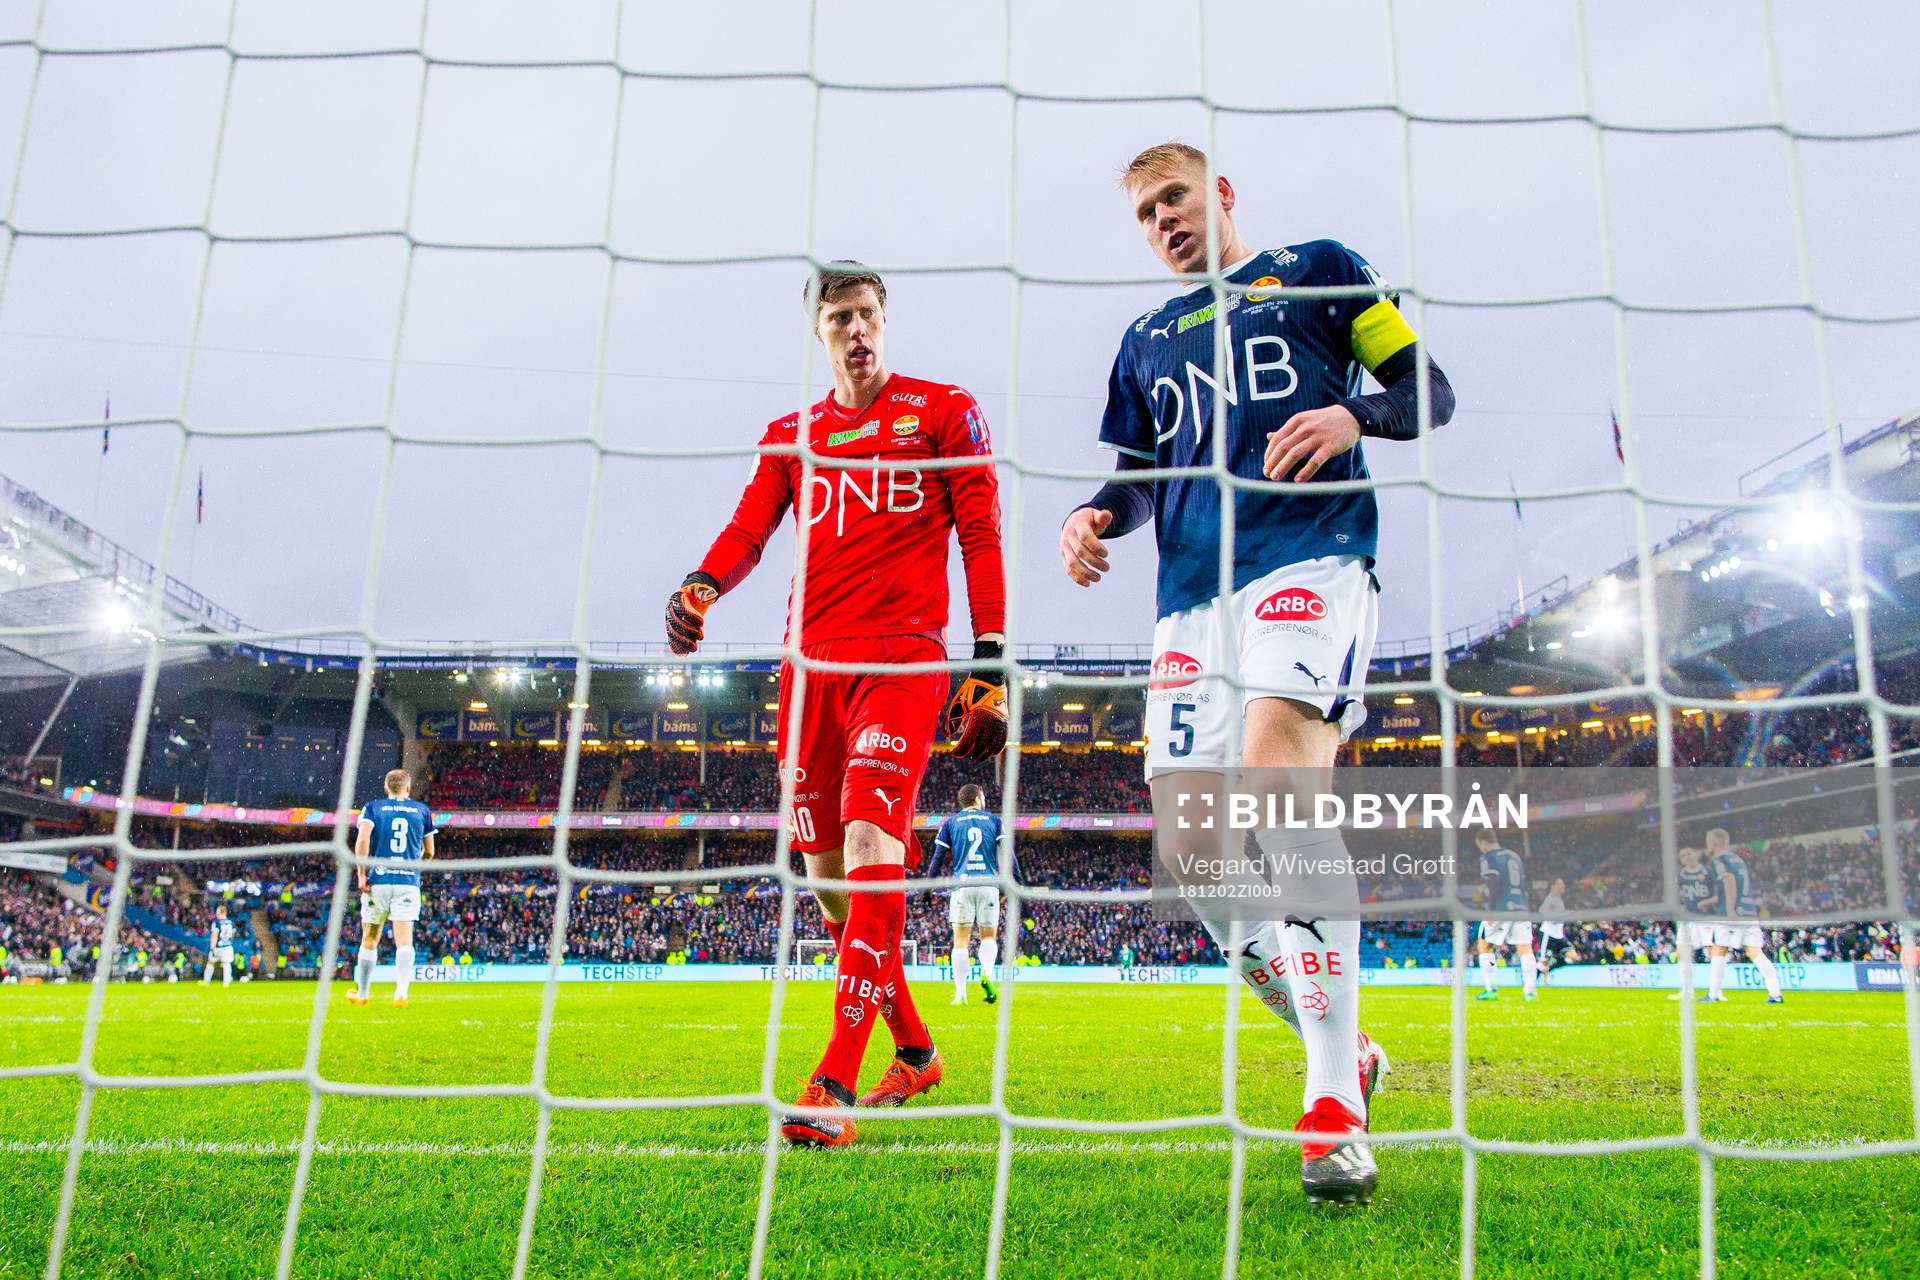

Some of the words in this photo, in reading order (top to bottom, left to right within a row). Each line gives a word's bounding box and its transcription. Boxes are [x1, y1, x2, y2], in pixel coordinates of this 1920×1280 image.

[1178, 302, 1219, 334] KIW
[1258, 596, 1328, 618] ARBO
[663, 719, 698, 733] bama
[1054, 720, 1088, 734] bama
[1168, 703, 1196, 758] 5
[1382, 715, 1421, 728] bama
[857, 732, 907, 753] ARBO
[899, 768, 909, 777] AS
[390, 817, 409, 853] 3
[968, 827, 984, 860] 2
[414, 966, 485, 981] ECHSTEP
[582, 965, 663, 981] TECHSTEP
[1240, 955, 1286, 987] IBE
[1735, 965, 1806, 988] TECSTEP
[838, 974, 883, 1006] TIBE
